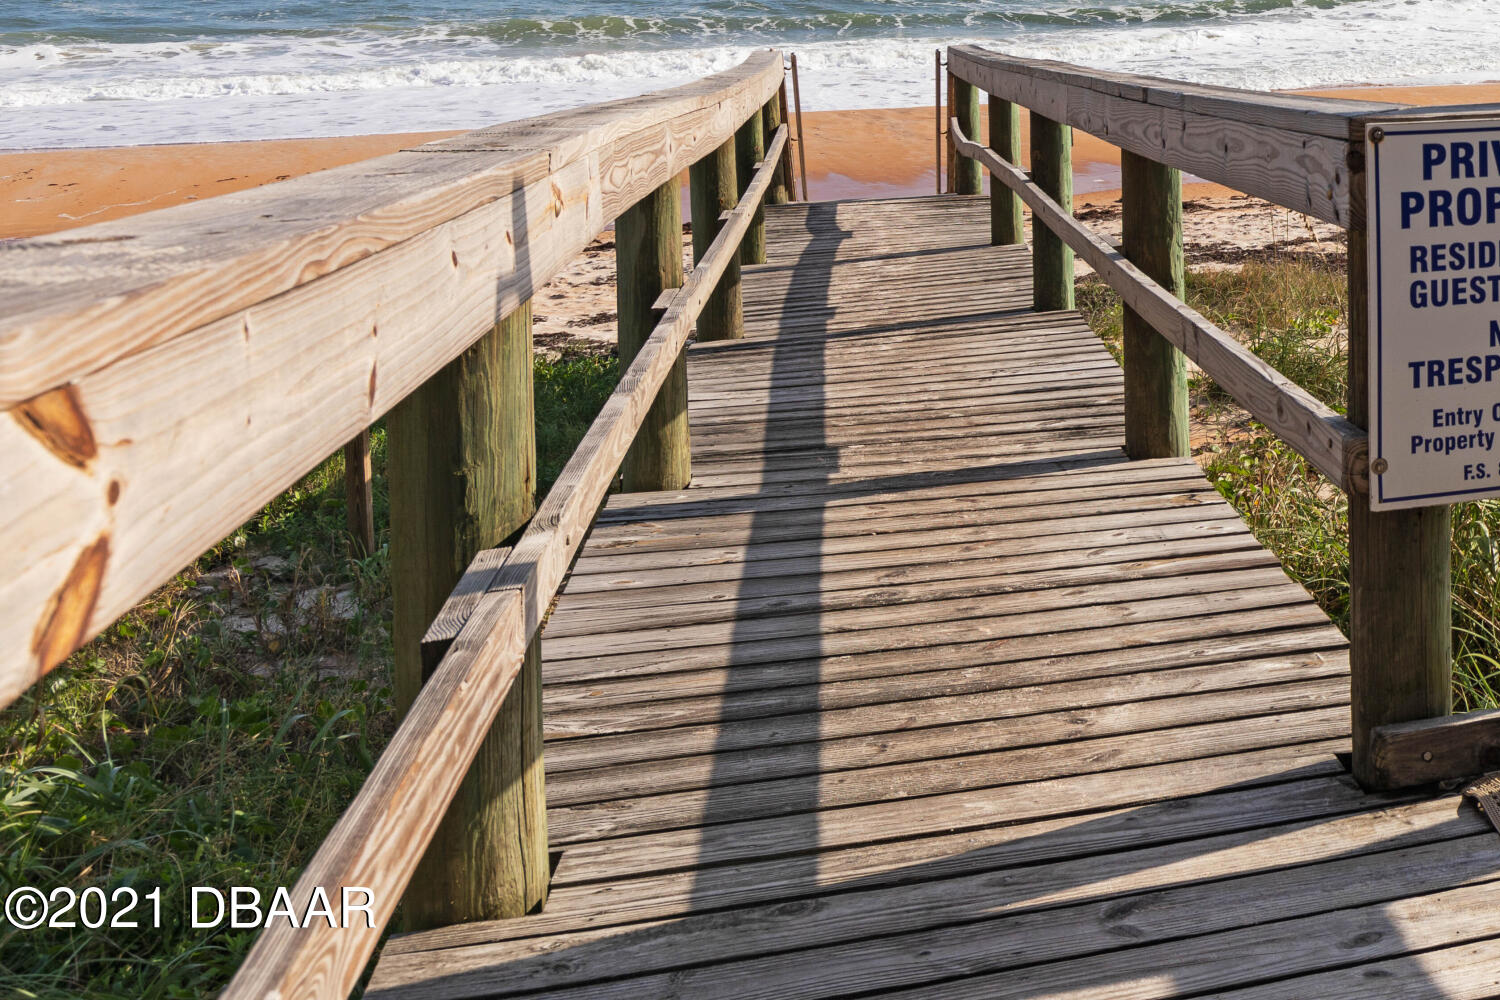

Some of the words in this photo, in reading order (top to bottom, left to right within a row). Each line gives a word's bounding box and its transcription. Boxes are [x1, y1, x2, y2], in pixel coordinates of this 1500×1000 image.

[1432, 407, 1483, 428] Entry
[1410, 430, 1495, 455] Property
[1463, 463, 1491, 481] F.S.
